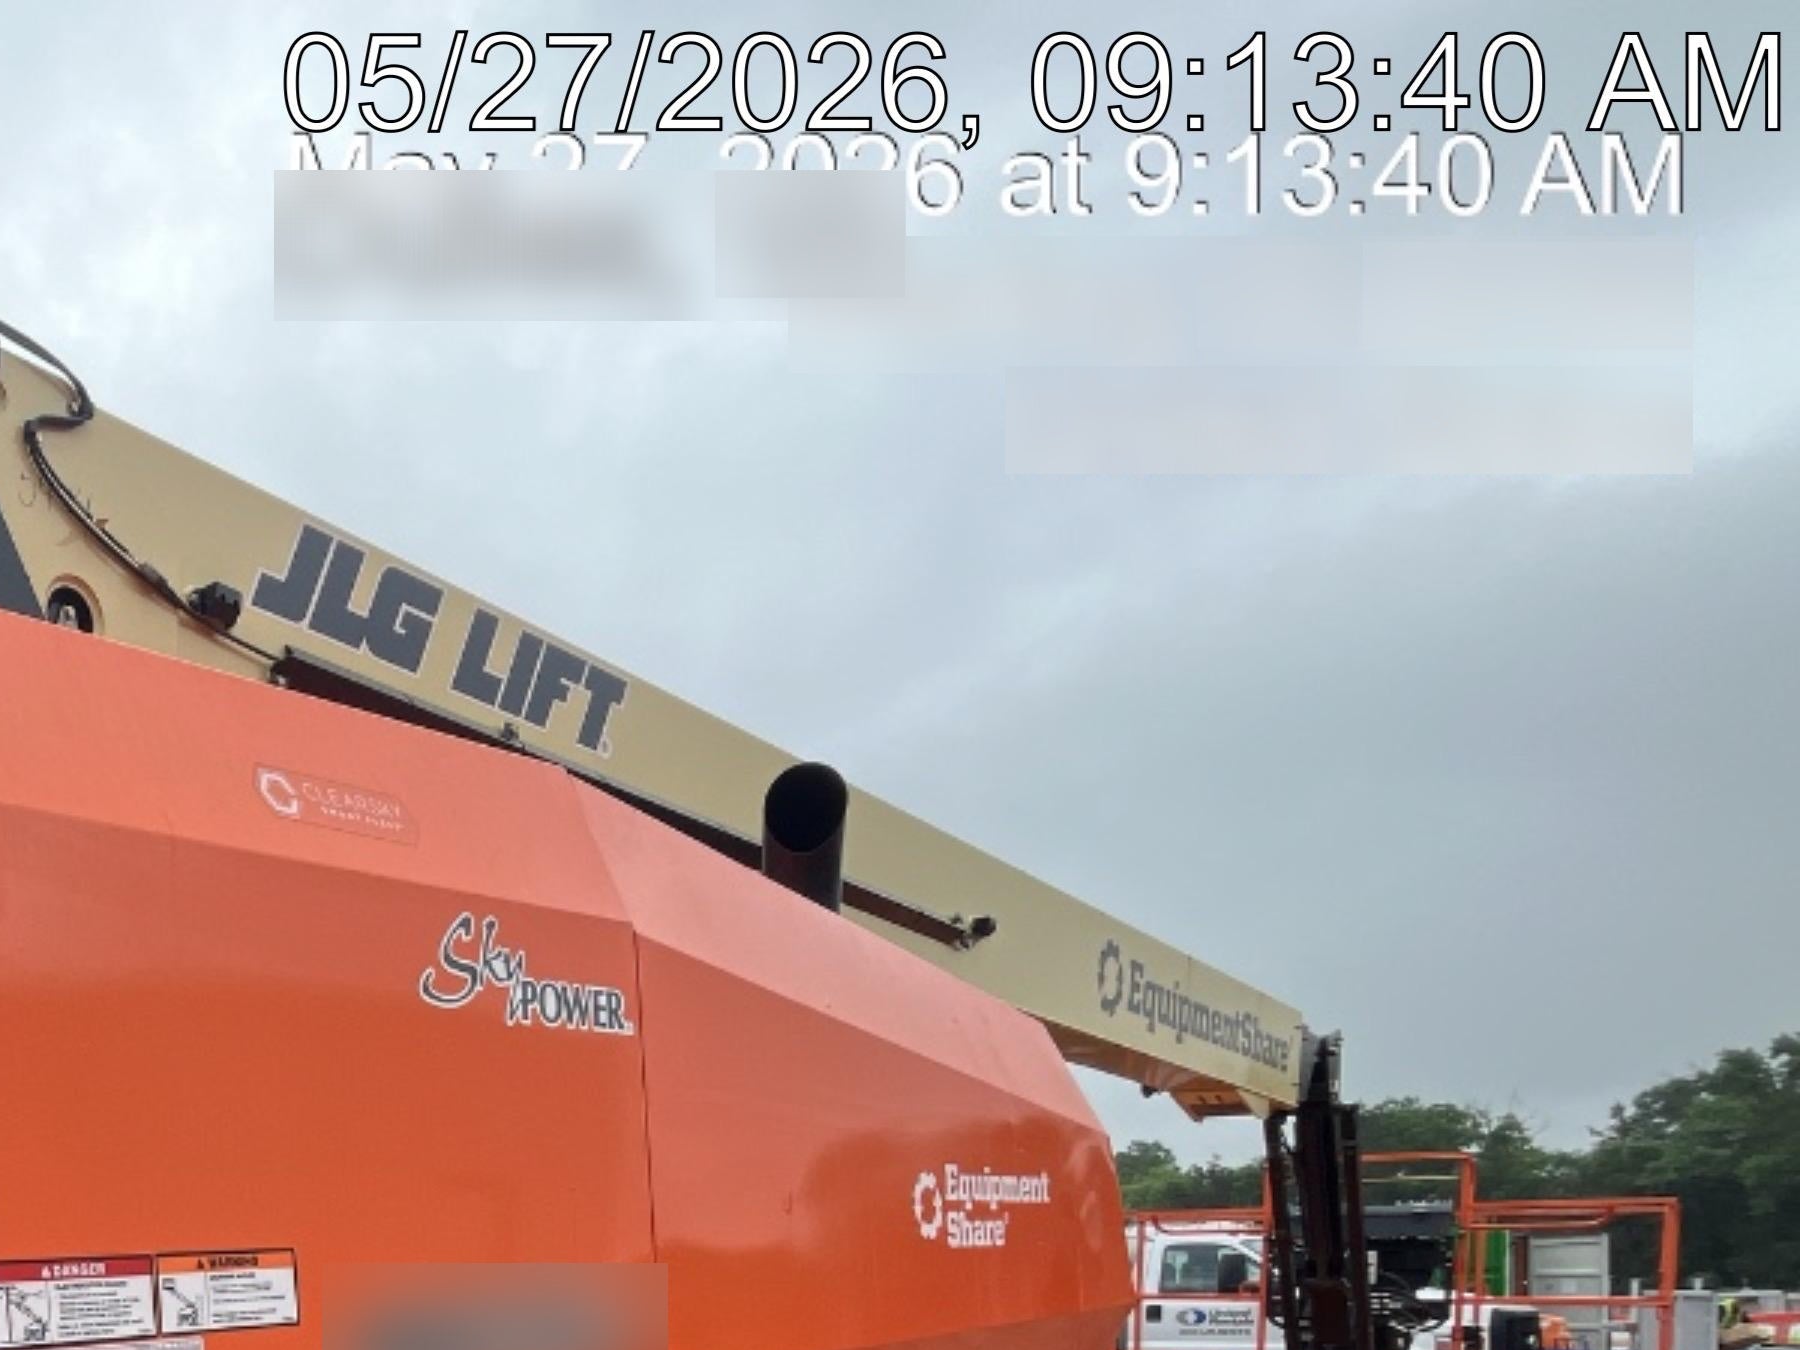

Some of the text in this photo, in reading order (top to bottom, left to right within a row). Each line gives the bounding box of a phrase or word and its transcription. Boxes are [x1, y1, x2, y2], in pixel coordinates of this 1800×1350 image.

[251, 523, 630, 753] JLG LIFT
[1128, 960, 1290, 1072] EquipmentShare
[944, 1164, 1050, 1209] Equipment
[947, 1213, 1006, 1248] Share
